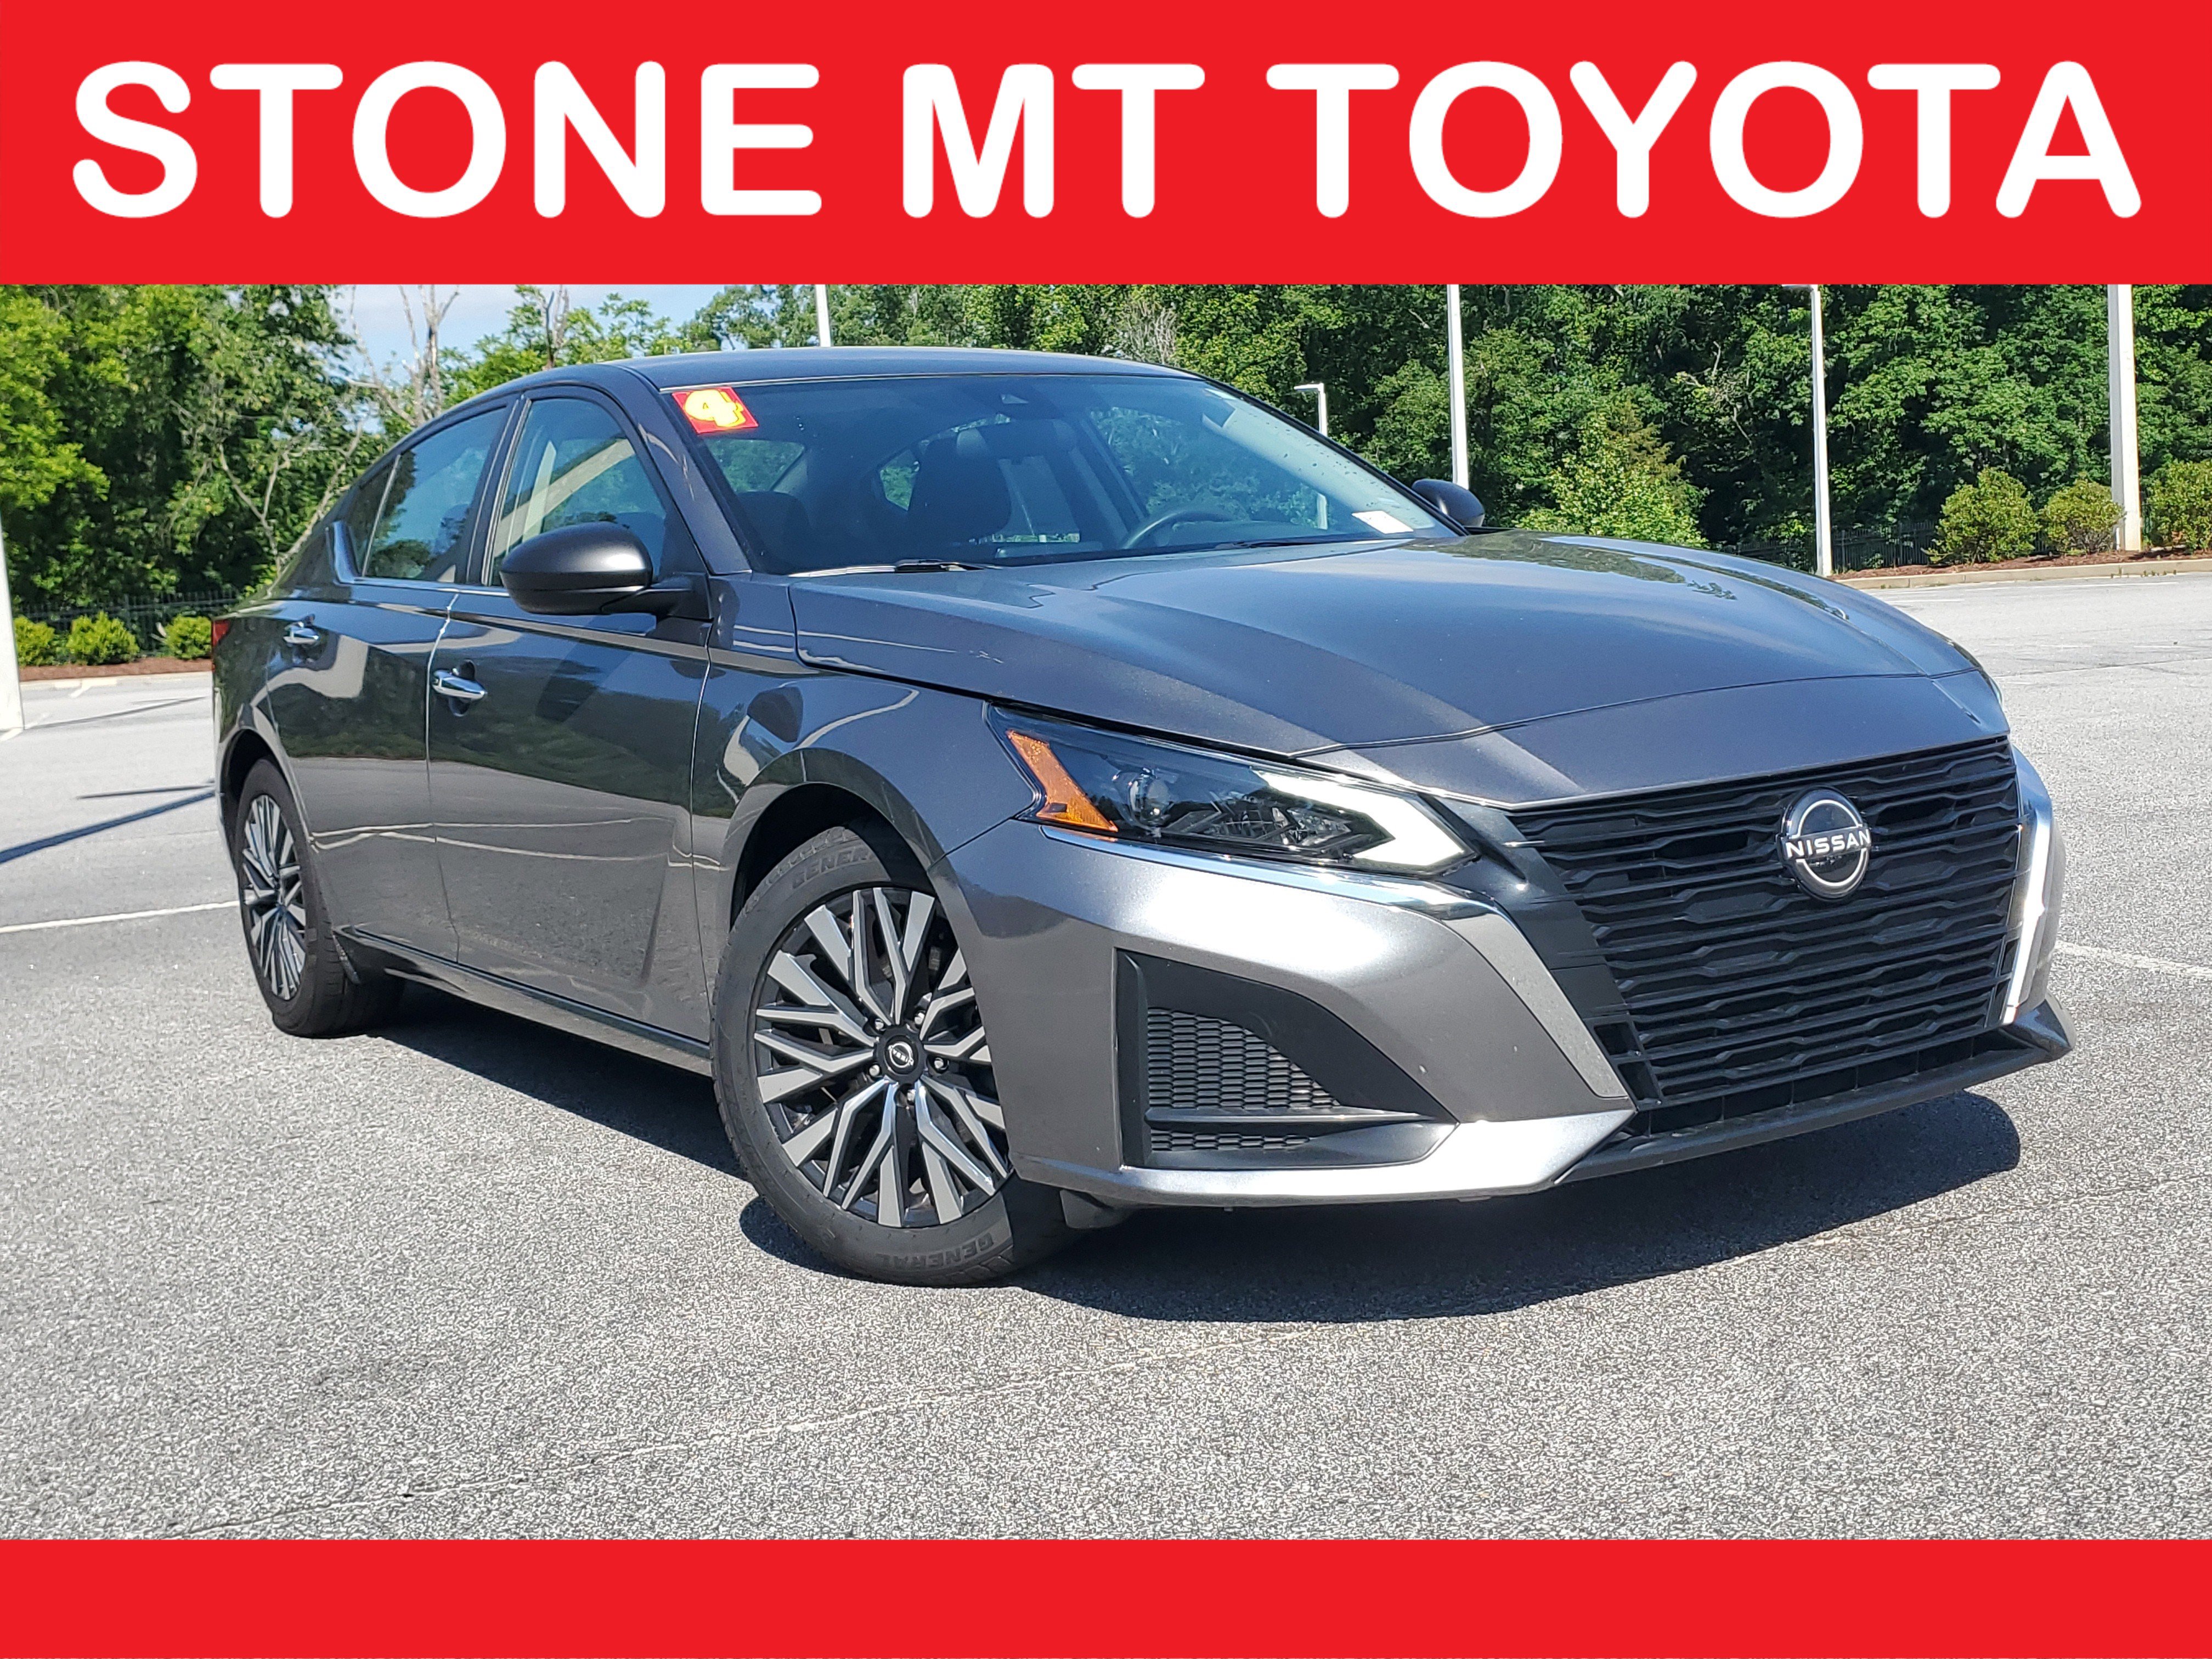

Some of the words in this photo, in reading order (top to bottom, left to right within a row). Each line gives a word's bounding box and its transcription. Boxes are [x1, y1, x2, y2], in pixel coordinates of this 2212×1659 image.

[685, 390, 746, 427] 4
[1785, 829, 1870, 857] NISSAN
[793, 843, 878, 889] GENER
[876, 1233, 994, 1267] GENERAL
